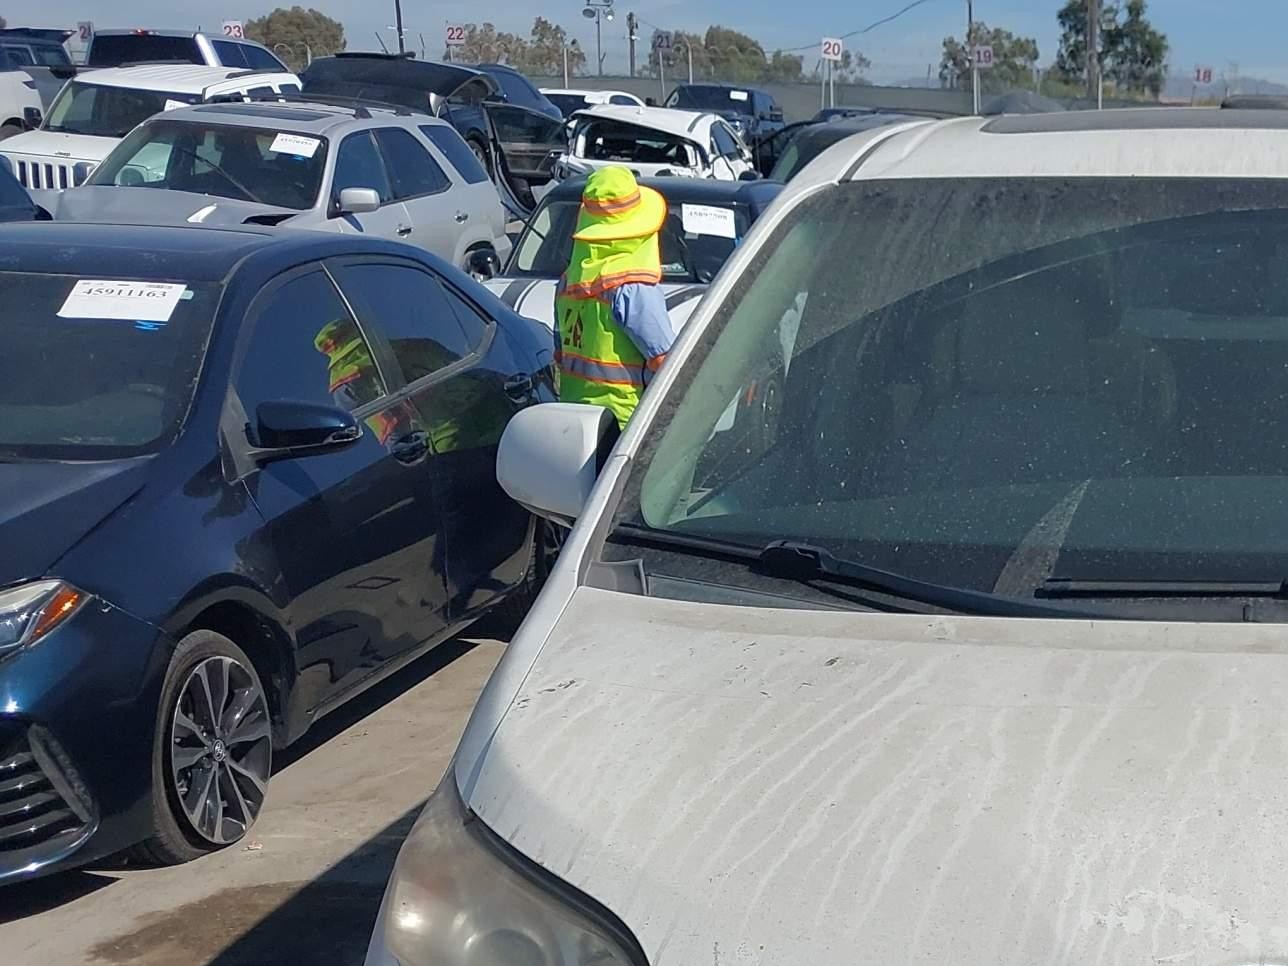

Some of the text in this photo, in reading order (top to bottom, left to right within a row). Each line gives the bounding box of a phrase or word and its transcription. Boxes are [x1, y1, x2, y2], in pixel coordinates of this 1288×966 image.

[223, 25, 243, 38] 23
[447, 26, 465, 40] 22
[656, 34, 671, 48] 21
[823, 41, 840, 56] 20
[976, 50, 991, 63] 19
[83, 287, 168, 298] 45911163
